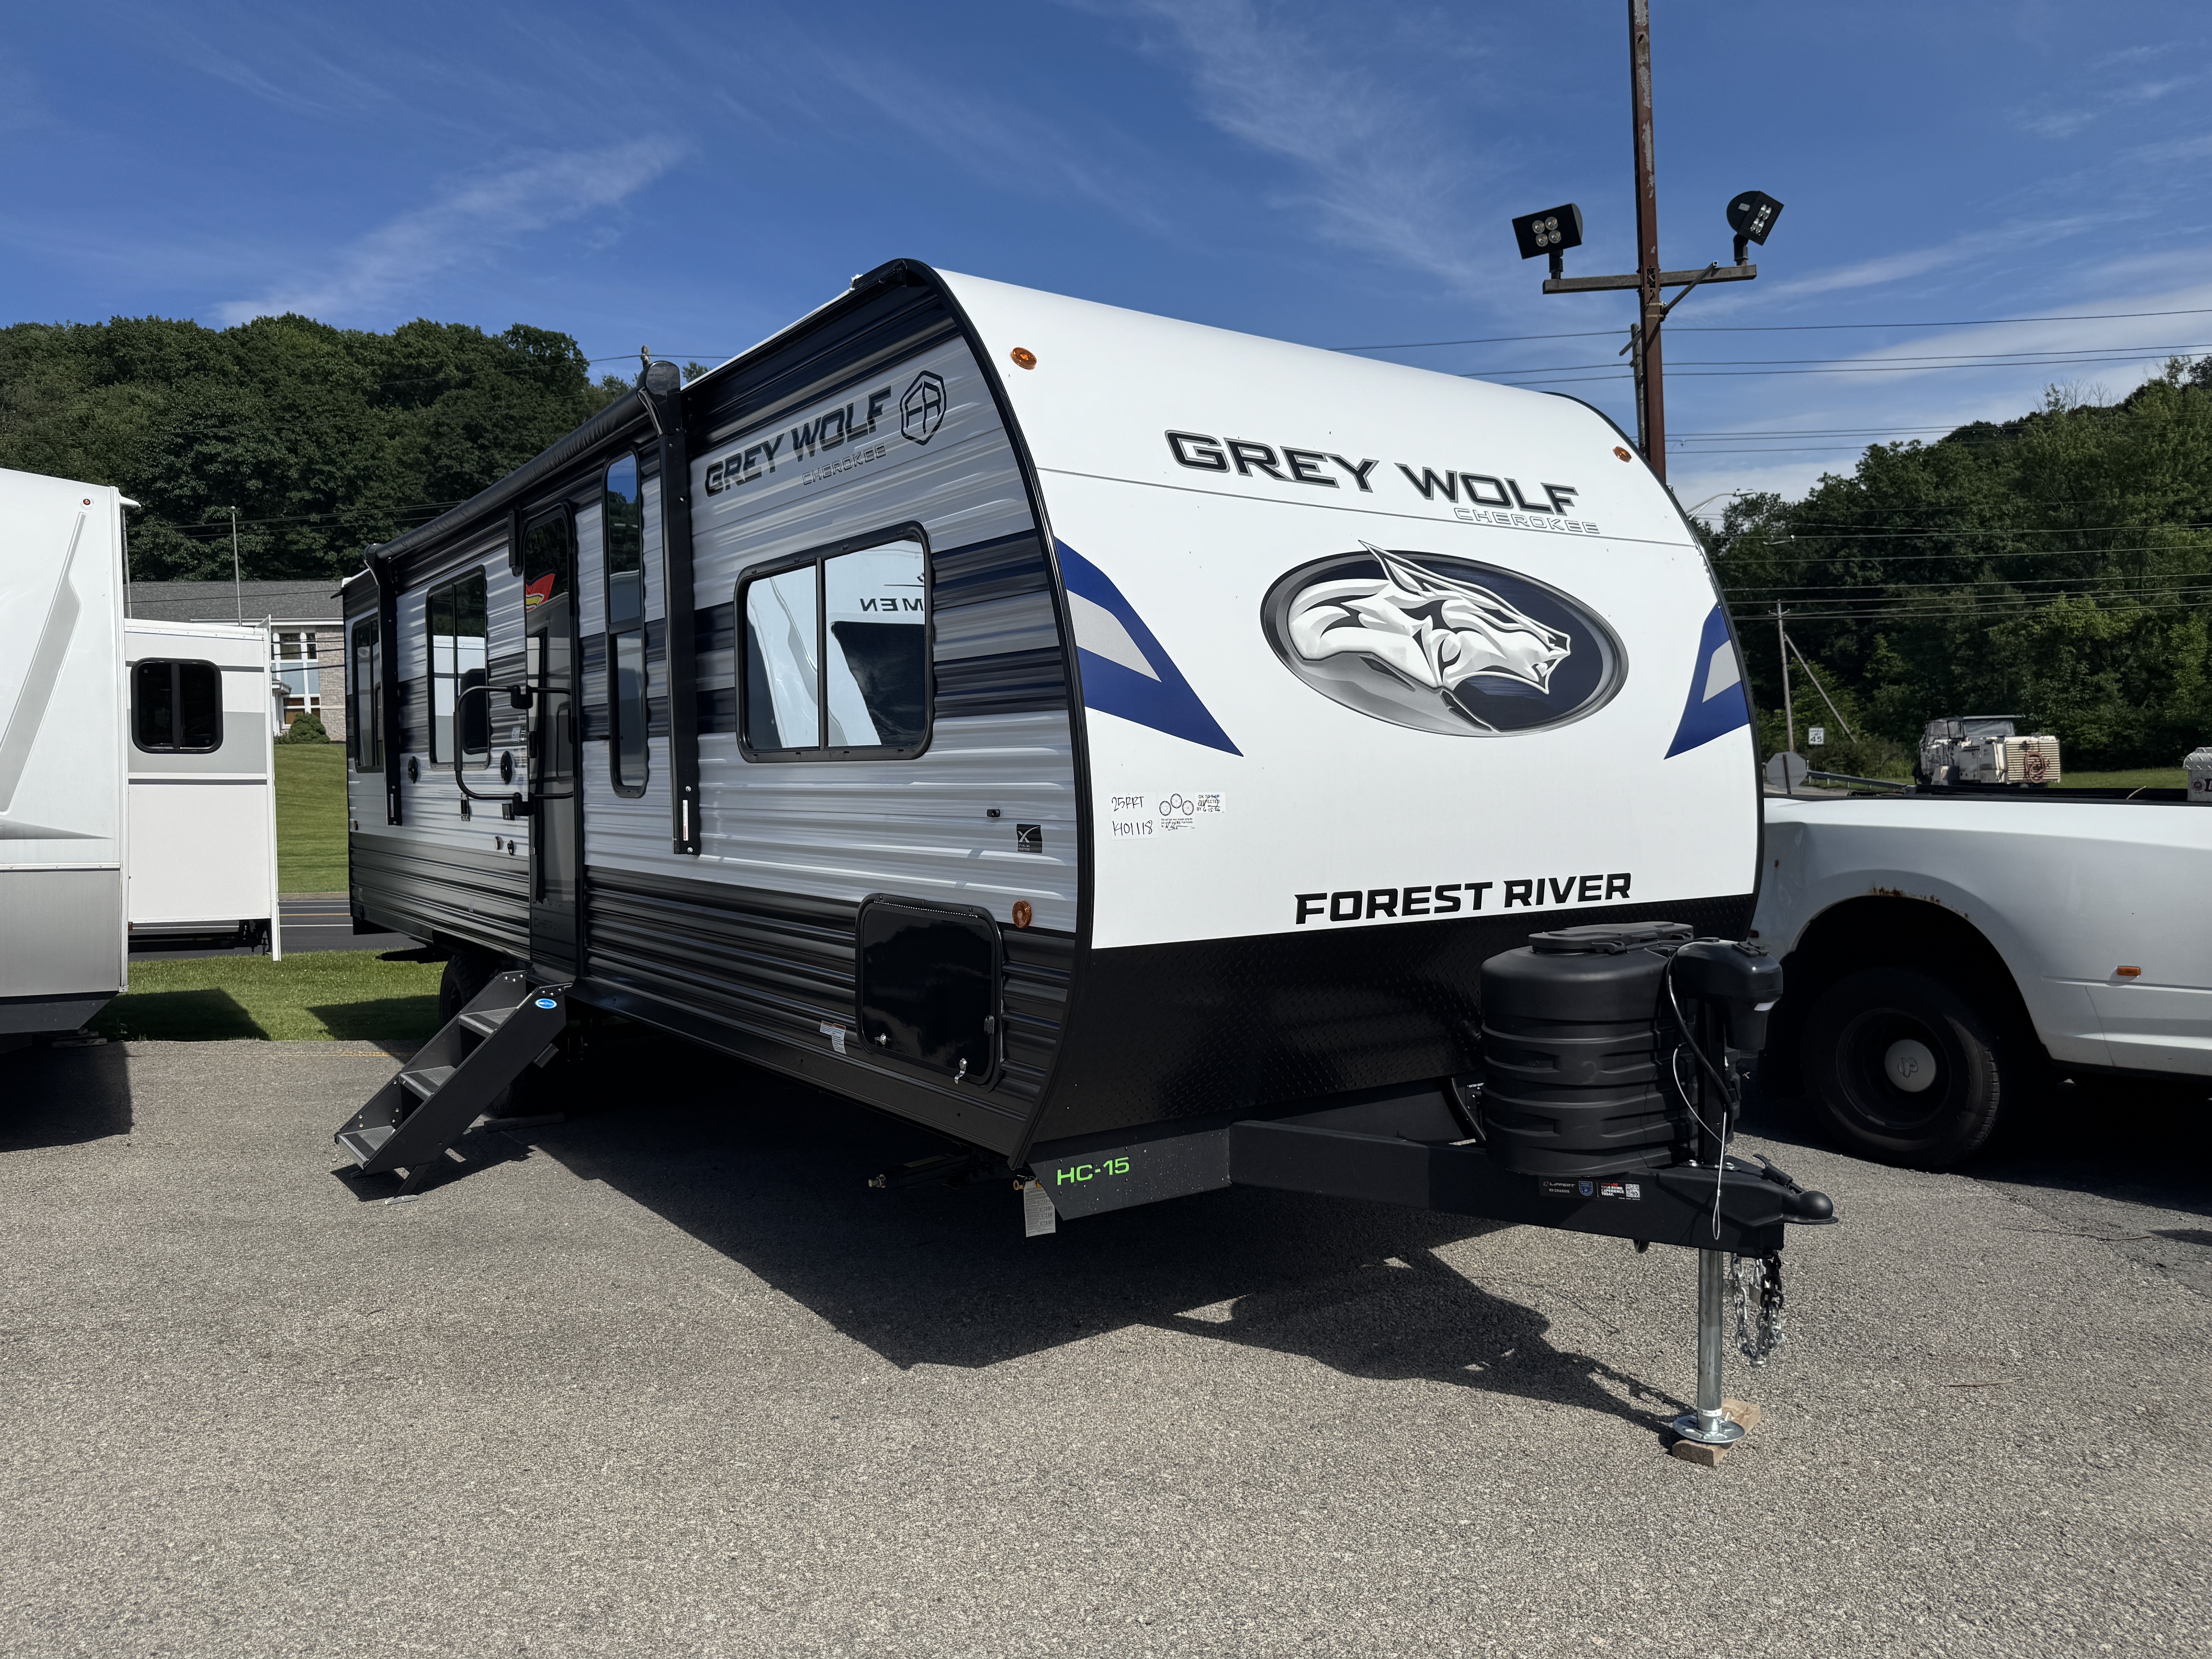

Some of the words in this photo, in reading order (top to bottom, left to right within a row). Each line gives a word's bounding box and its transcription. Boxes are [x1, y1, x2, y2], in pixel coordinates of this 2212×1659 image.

[705, 433, 784, 497] GREY
[791, 386, 891, 462] WOLF
[802, 443, 886, 486] CHEROKEE
[1164, 429, 1379, 493] GREY
[1394, 463, 1579, 515] WOLF
[1453, 507, 1600, 534] CHEROKEE
[1294, 881, 1493, 924] FOREST
[1503, 872, 1631, 908] RIVER
[1057, 1157, 1130, 1185] HC-15
